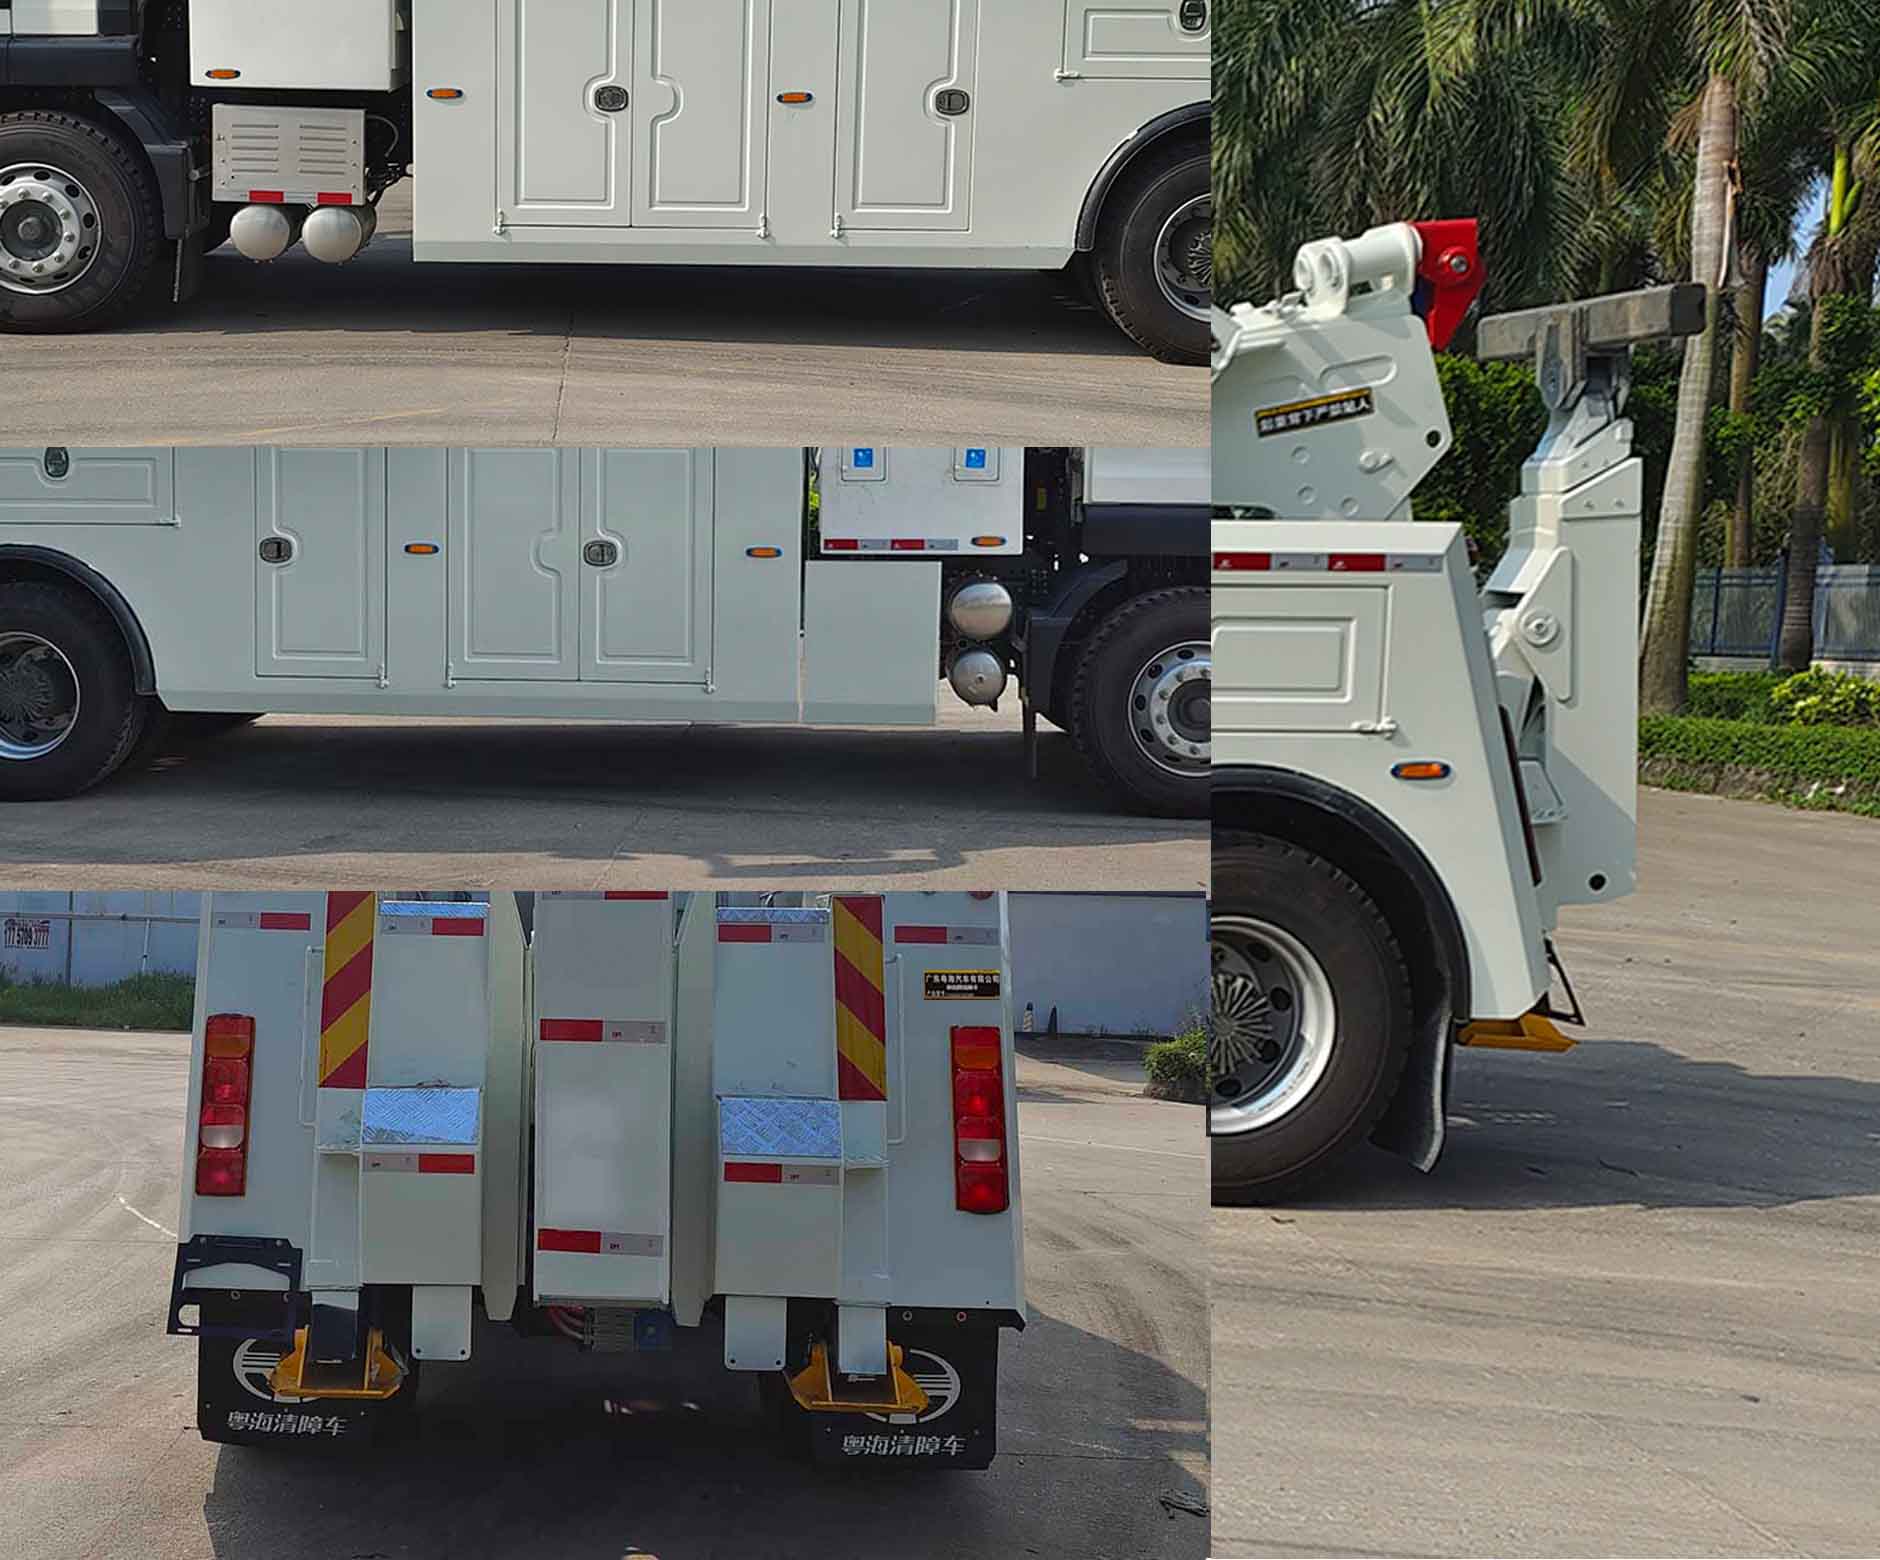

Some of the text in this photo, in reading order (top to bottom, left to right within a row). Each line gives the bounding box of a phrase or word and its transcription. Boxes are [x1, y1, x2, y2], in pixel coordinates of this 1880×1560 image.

[227, 1410, 348, 1436] 粤海清障车
[841, 1434, 966, 1457] 粤海清障车
